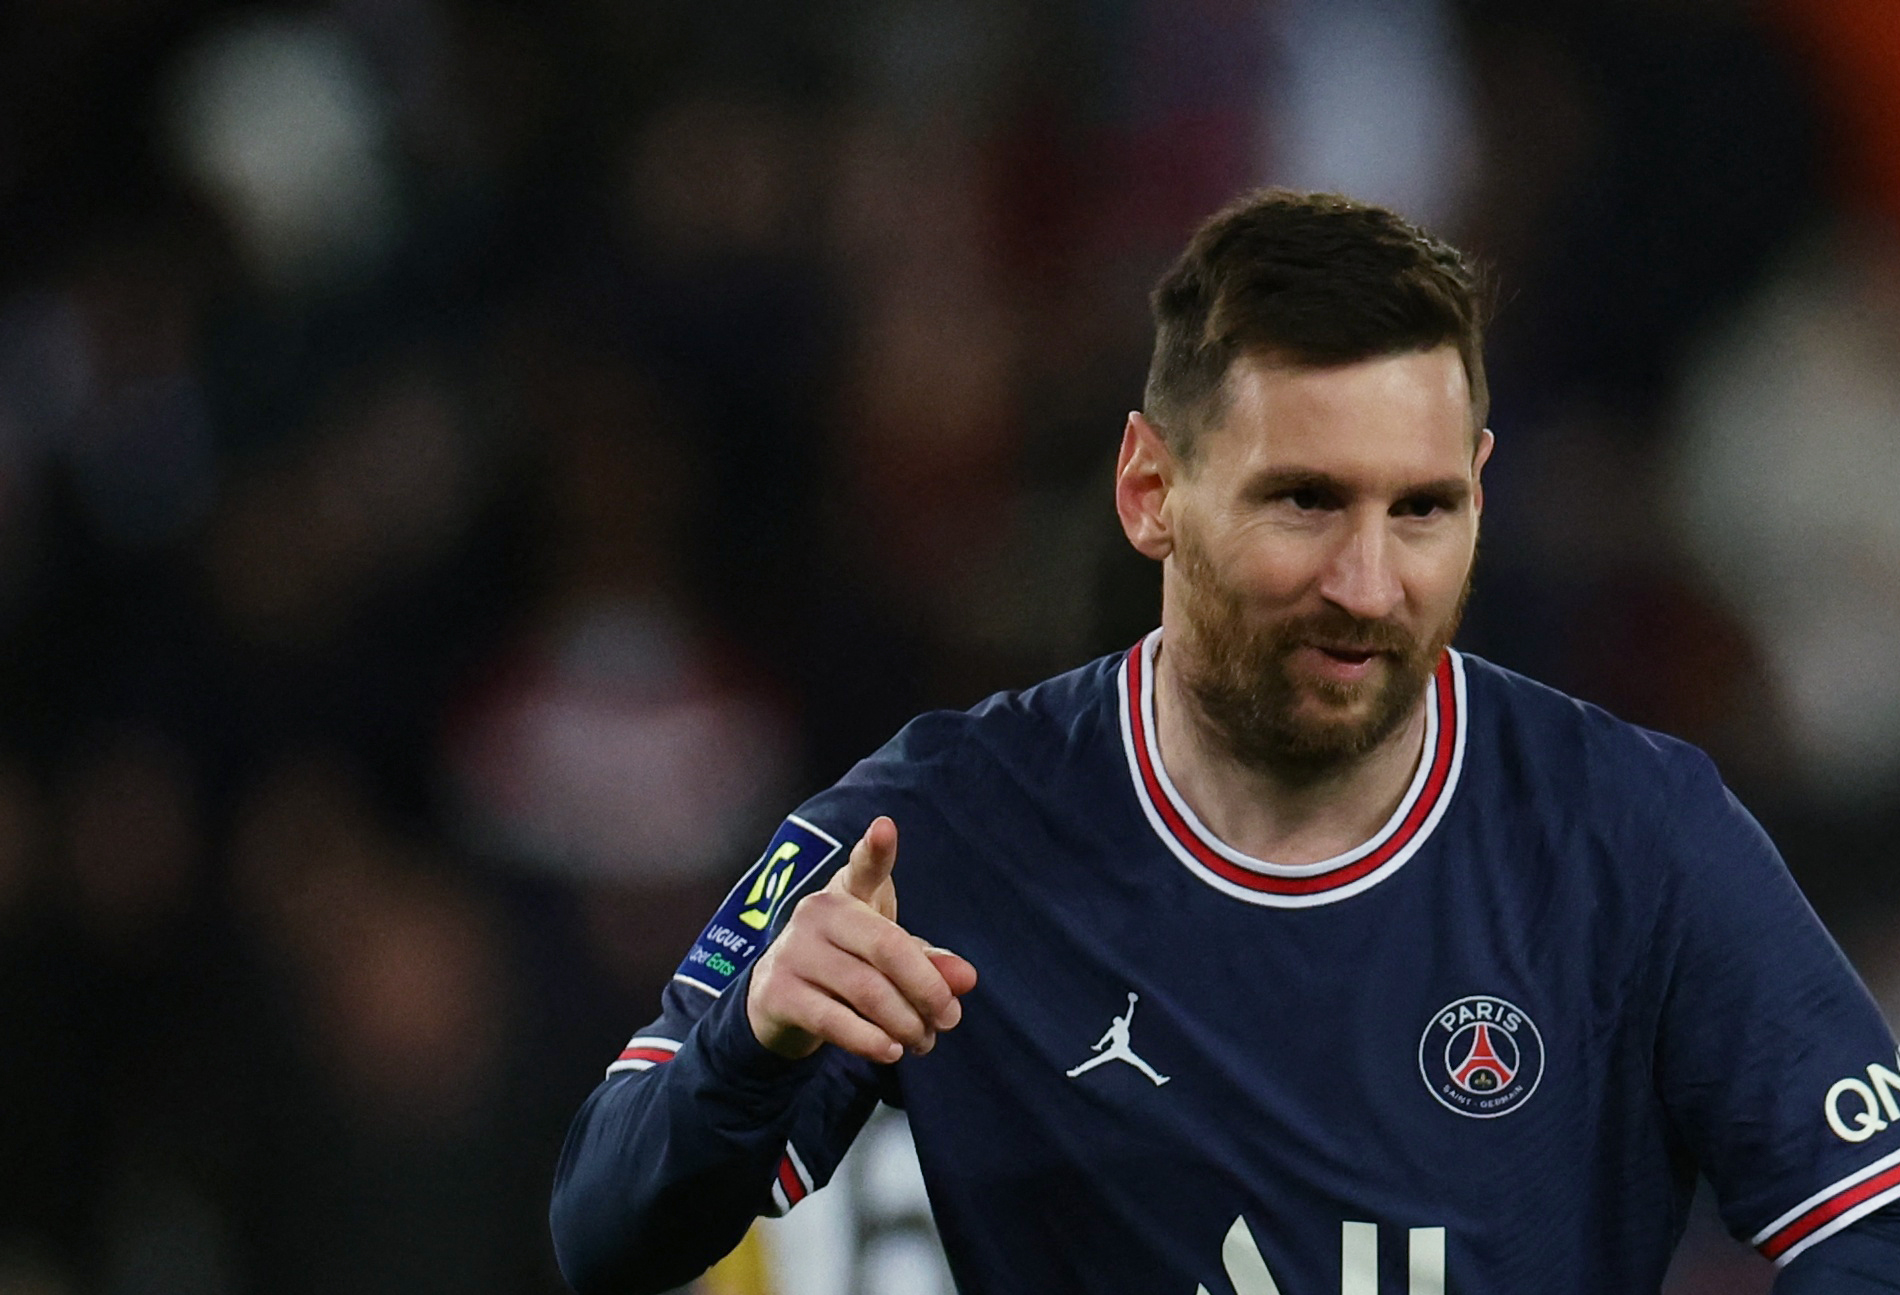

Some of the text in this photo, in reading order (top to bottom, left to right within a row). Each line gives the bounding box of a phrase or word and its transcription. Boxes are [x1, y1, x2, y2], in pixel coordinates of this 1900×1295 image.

[706, 924, 756, 958] LIGUE 1
[705, 952, 736, 977] Eats
[1439, 1001, 1522, 1033] PARIS
